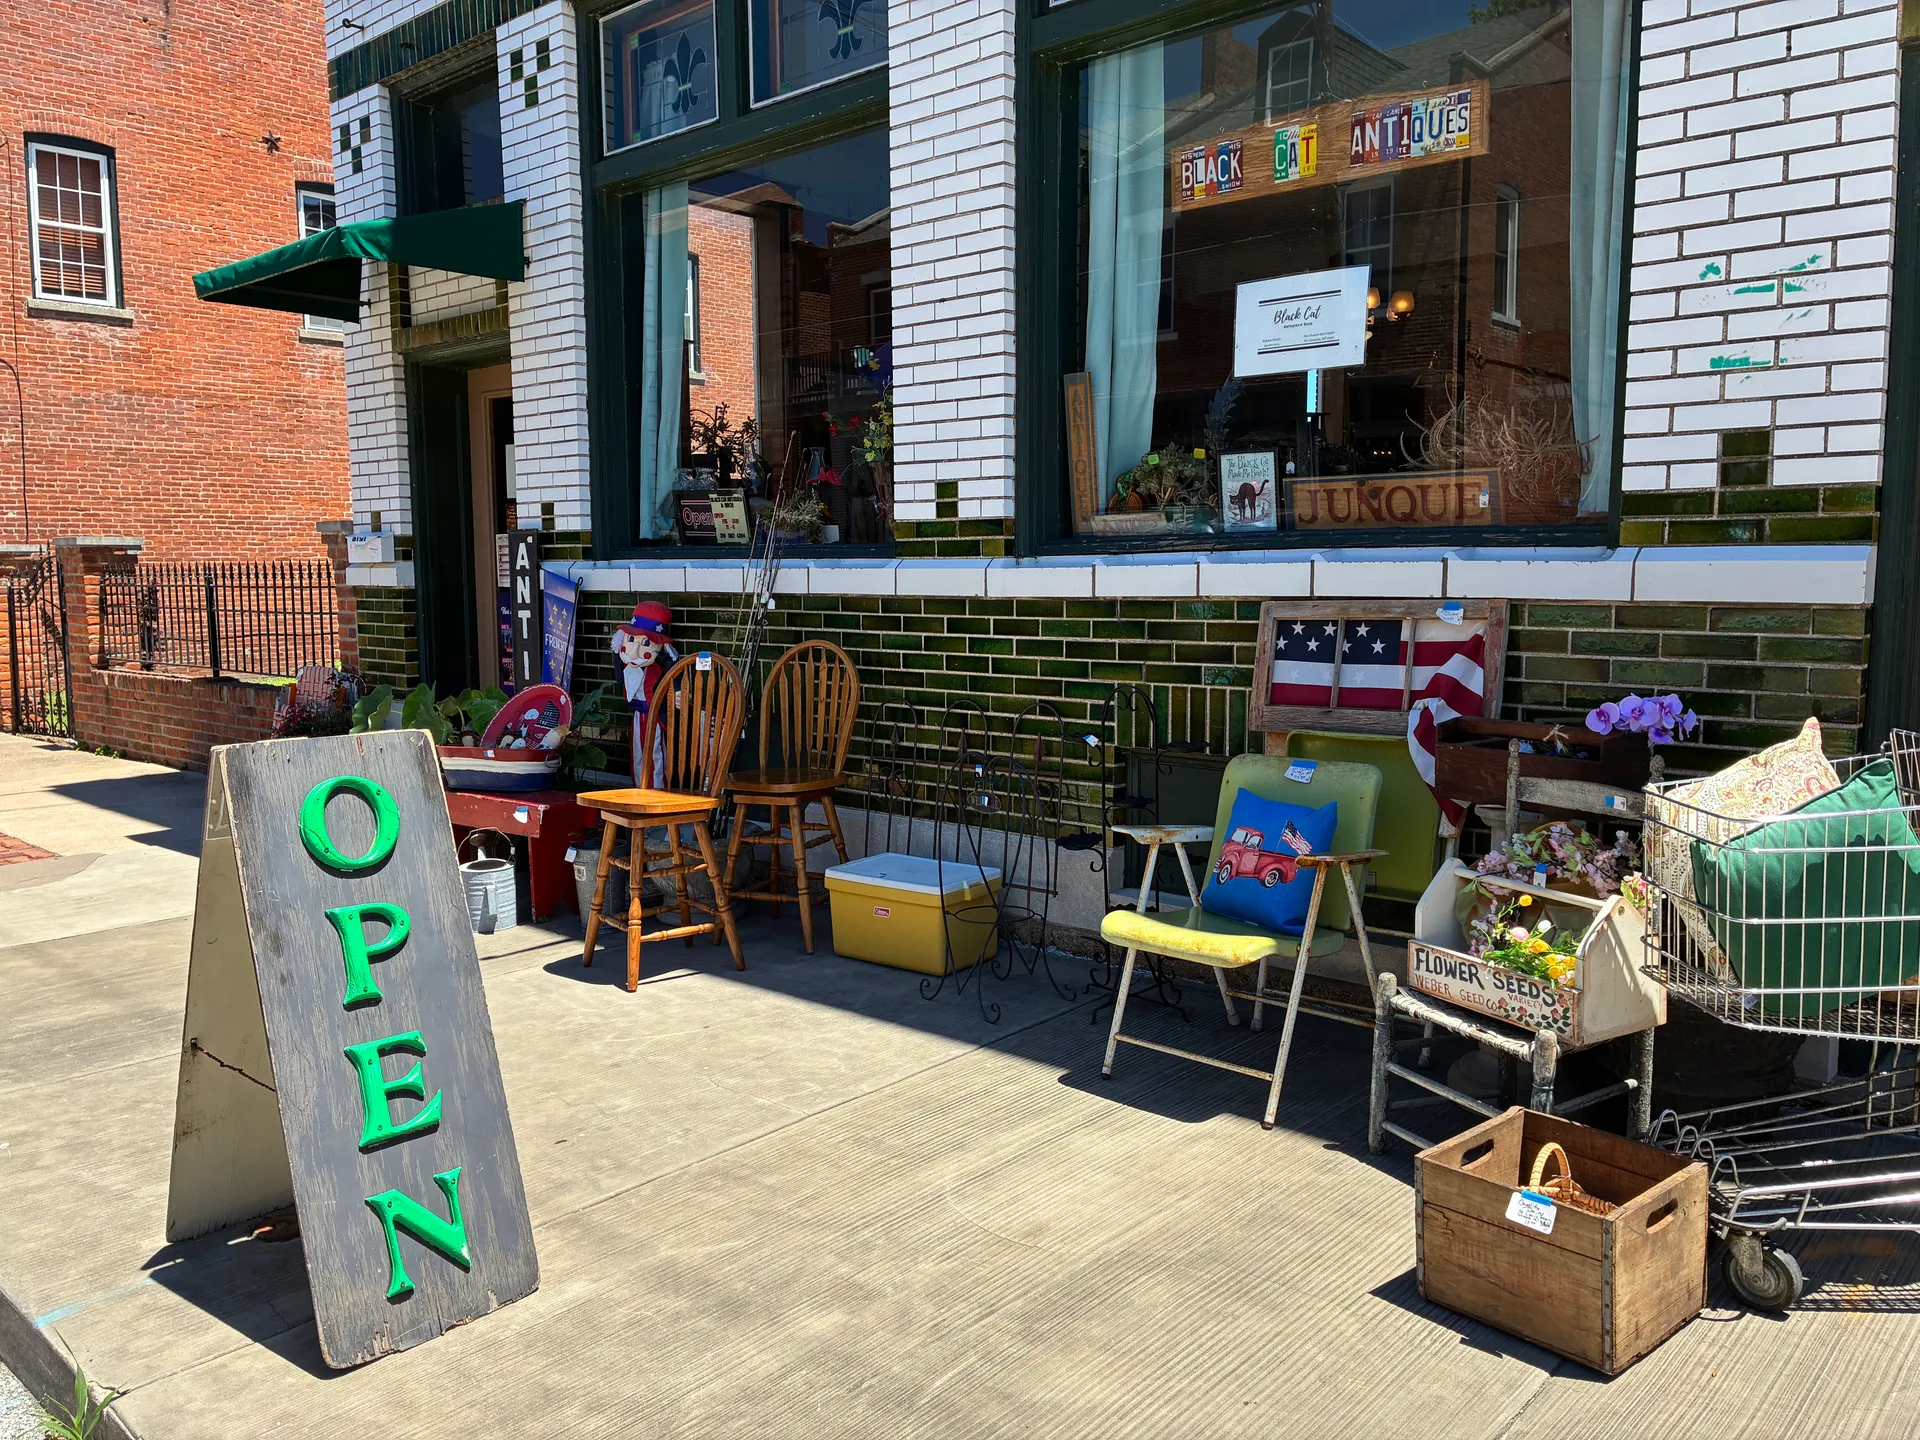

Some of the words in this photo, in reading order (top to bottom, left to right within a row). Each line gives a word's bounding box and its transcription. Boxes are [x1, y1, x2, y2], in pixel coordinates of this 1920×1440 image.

[1182, 151, 1242, 189] BLACK
[1275, 136, 1315, 170] CAT
[1273, 307, 1302, 325] Black
[1303, 304, 1322, 320] Cat
[1237, 455, 1260, 470] Black
[683, 507, 715, 529] Open
[1298, 482, 1485, 525] JUNQUE
[515, 542, 532, 690] ANTI
[1414, 948, 1485, 990] FLOWER
[1492, 971, 1557, 1008] SEEDS
[1415, 973, 1453, 999] WEBER
[1459, 988, 1486, 1006] SEED
[1507, 993, 1544, 1013] VARIETY
[299, 775, 472, 1299] OPEN
